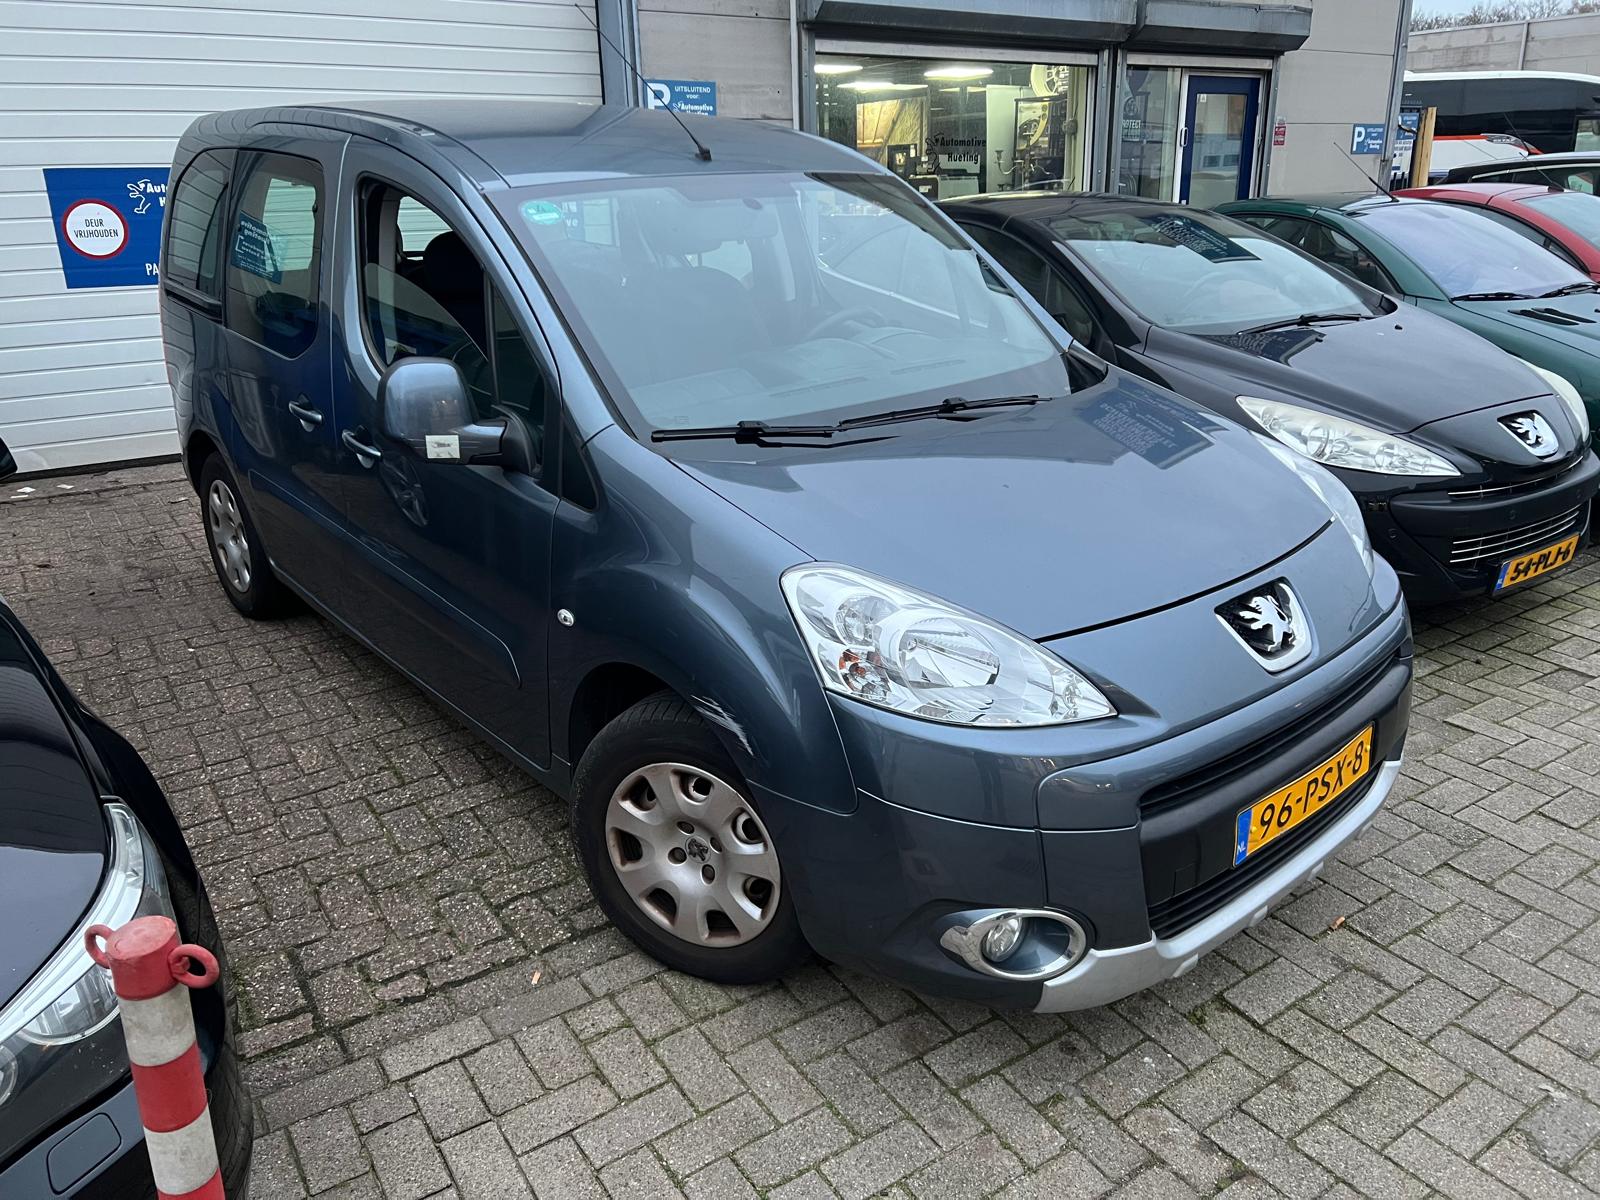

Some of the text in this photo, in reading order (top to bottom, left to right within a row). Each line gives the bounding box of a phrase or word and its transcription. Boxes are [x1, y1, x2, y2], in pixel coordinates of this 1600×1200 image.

[674, 85, 711, 94] UITSLUITEND
[647, 82, 671, 110] P
[681, 103, 714, 111] Automotive
[940, 136, 986, 147] Automotive
[1352, 127, 1366, 151] P
[947, 152, 979, 164] Hueting
[84, 218, 104, 227] DEUR
[74, 228, 119, 239] VRIJHOUDEN
[1510, 541, 1573, 582] 54-PLJ-6
[1260, 740, 1364, 839] 96-PSX-8
